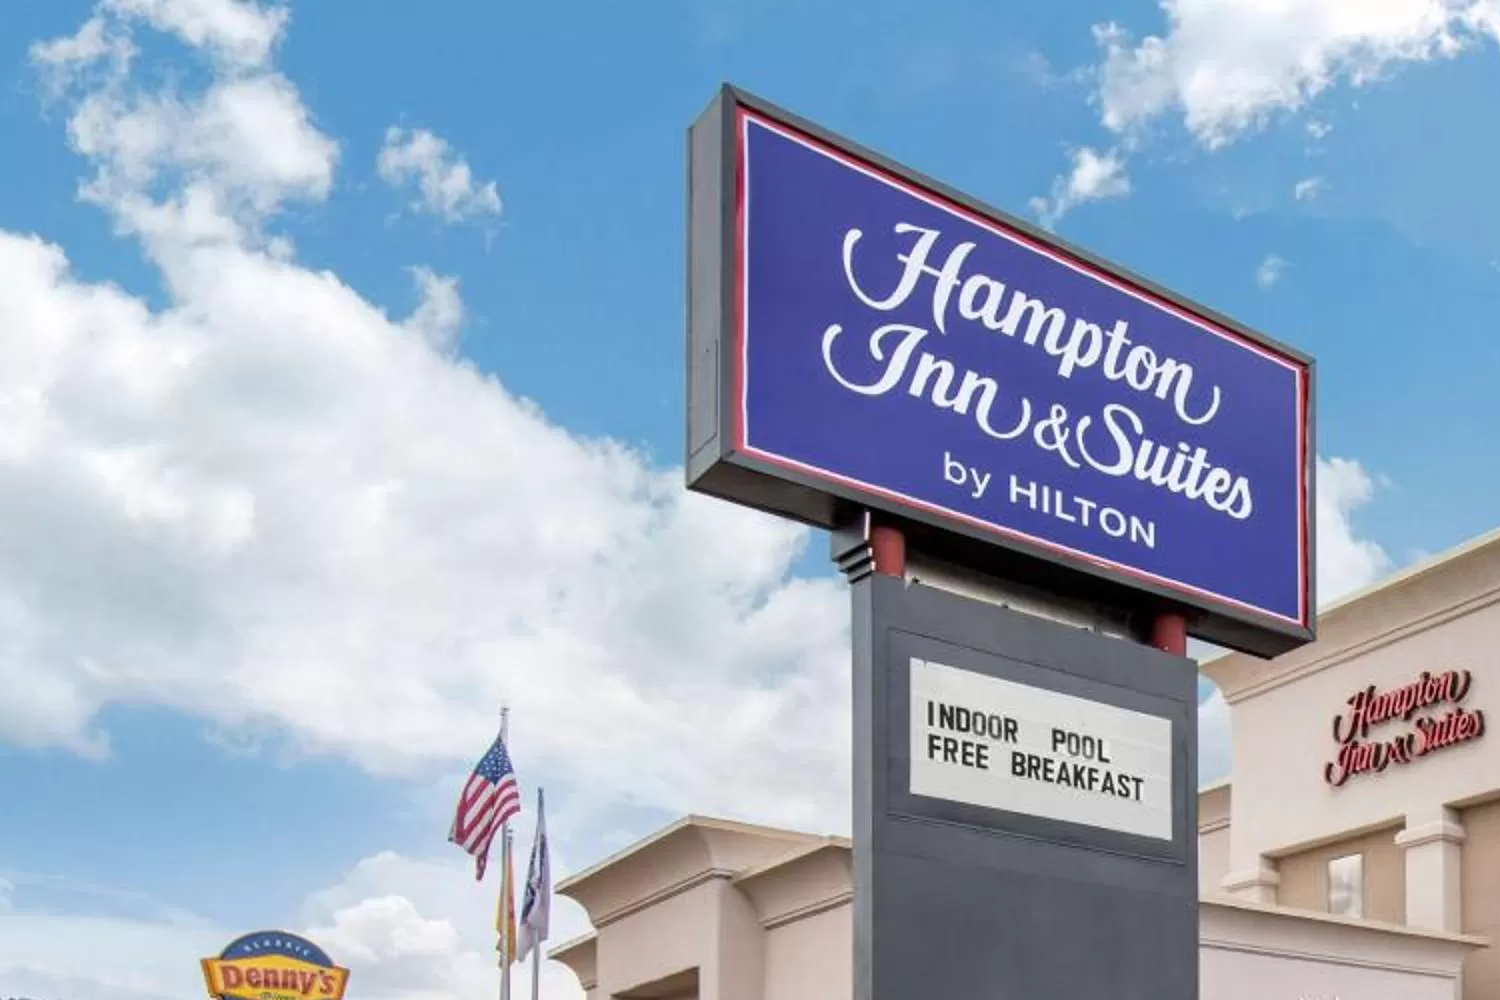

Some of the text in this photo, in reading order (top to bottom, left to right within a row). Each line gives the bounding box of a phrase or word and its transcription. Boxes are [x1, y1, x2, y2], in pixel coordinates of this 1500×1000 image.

[842, 222, 1221, 425] Hampton
[821, 323, 1253, 519] Inn & Suites
[943, 451, 1155, 549] by HILTON
[927, 700, 1111, 764] INDOOR POOL
[1333, 669, 1473, 744] Hampton
[927, 733, 1145, 801] FREE BREAKFAST
[1324, 740, 1391, 787] Inn
[1406, 708, 1486, 757] Suites
[220, 964, 337, 995] Denny's
